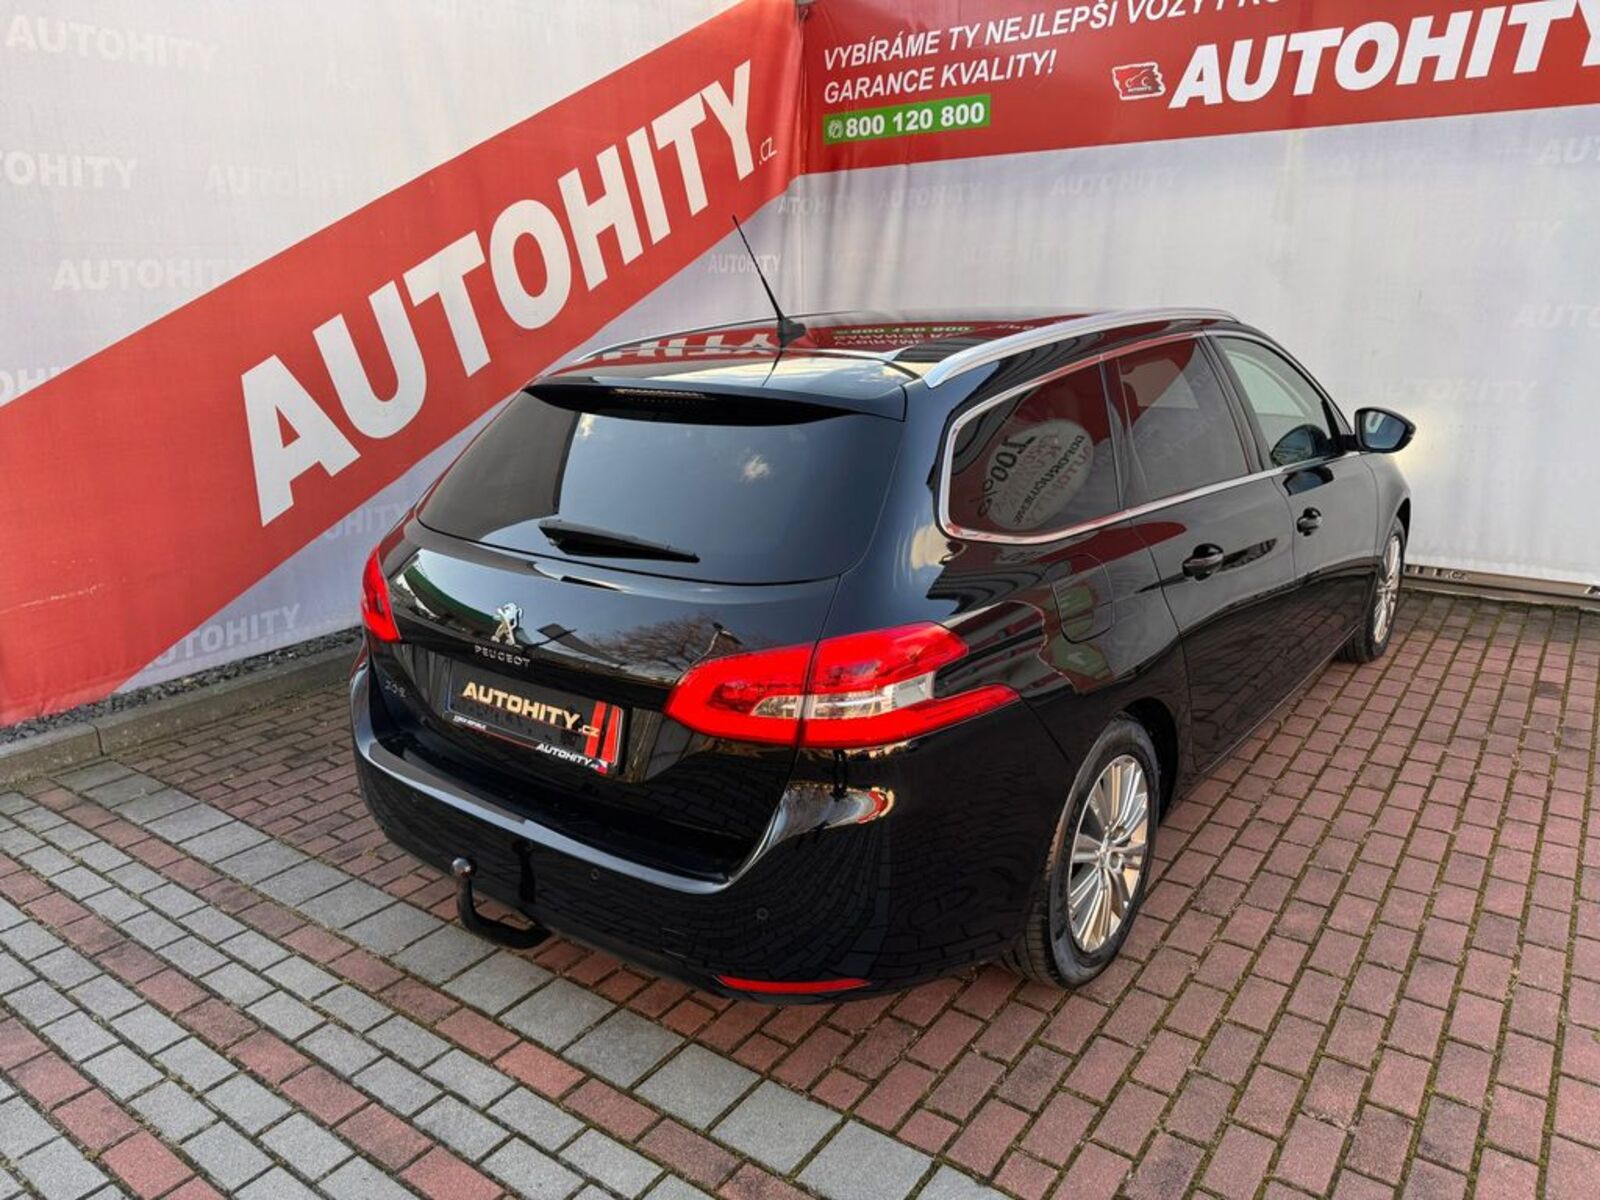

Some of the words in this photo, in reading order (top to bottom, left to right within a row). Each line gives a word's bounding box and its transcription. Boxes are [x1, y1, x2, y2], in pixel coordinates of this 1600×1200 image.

[6, 13, 219, 72] AUTOHITY
[823, 30, 941, 72] VYBÍRÁME
[948, 22, 981, 51] TY
[824, 66, 935, 104] GARANCE
[940, 49, 1057, 88] KVALITY!
[845, 115, 885, 137] 800
[893, 108, 933, 132] 120
[940, 102, 985, 127] 800
[0, 150, 137, 189] OHITY
[473, 645, 531, 667] PEUGEOT
